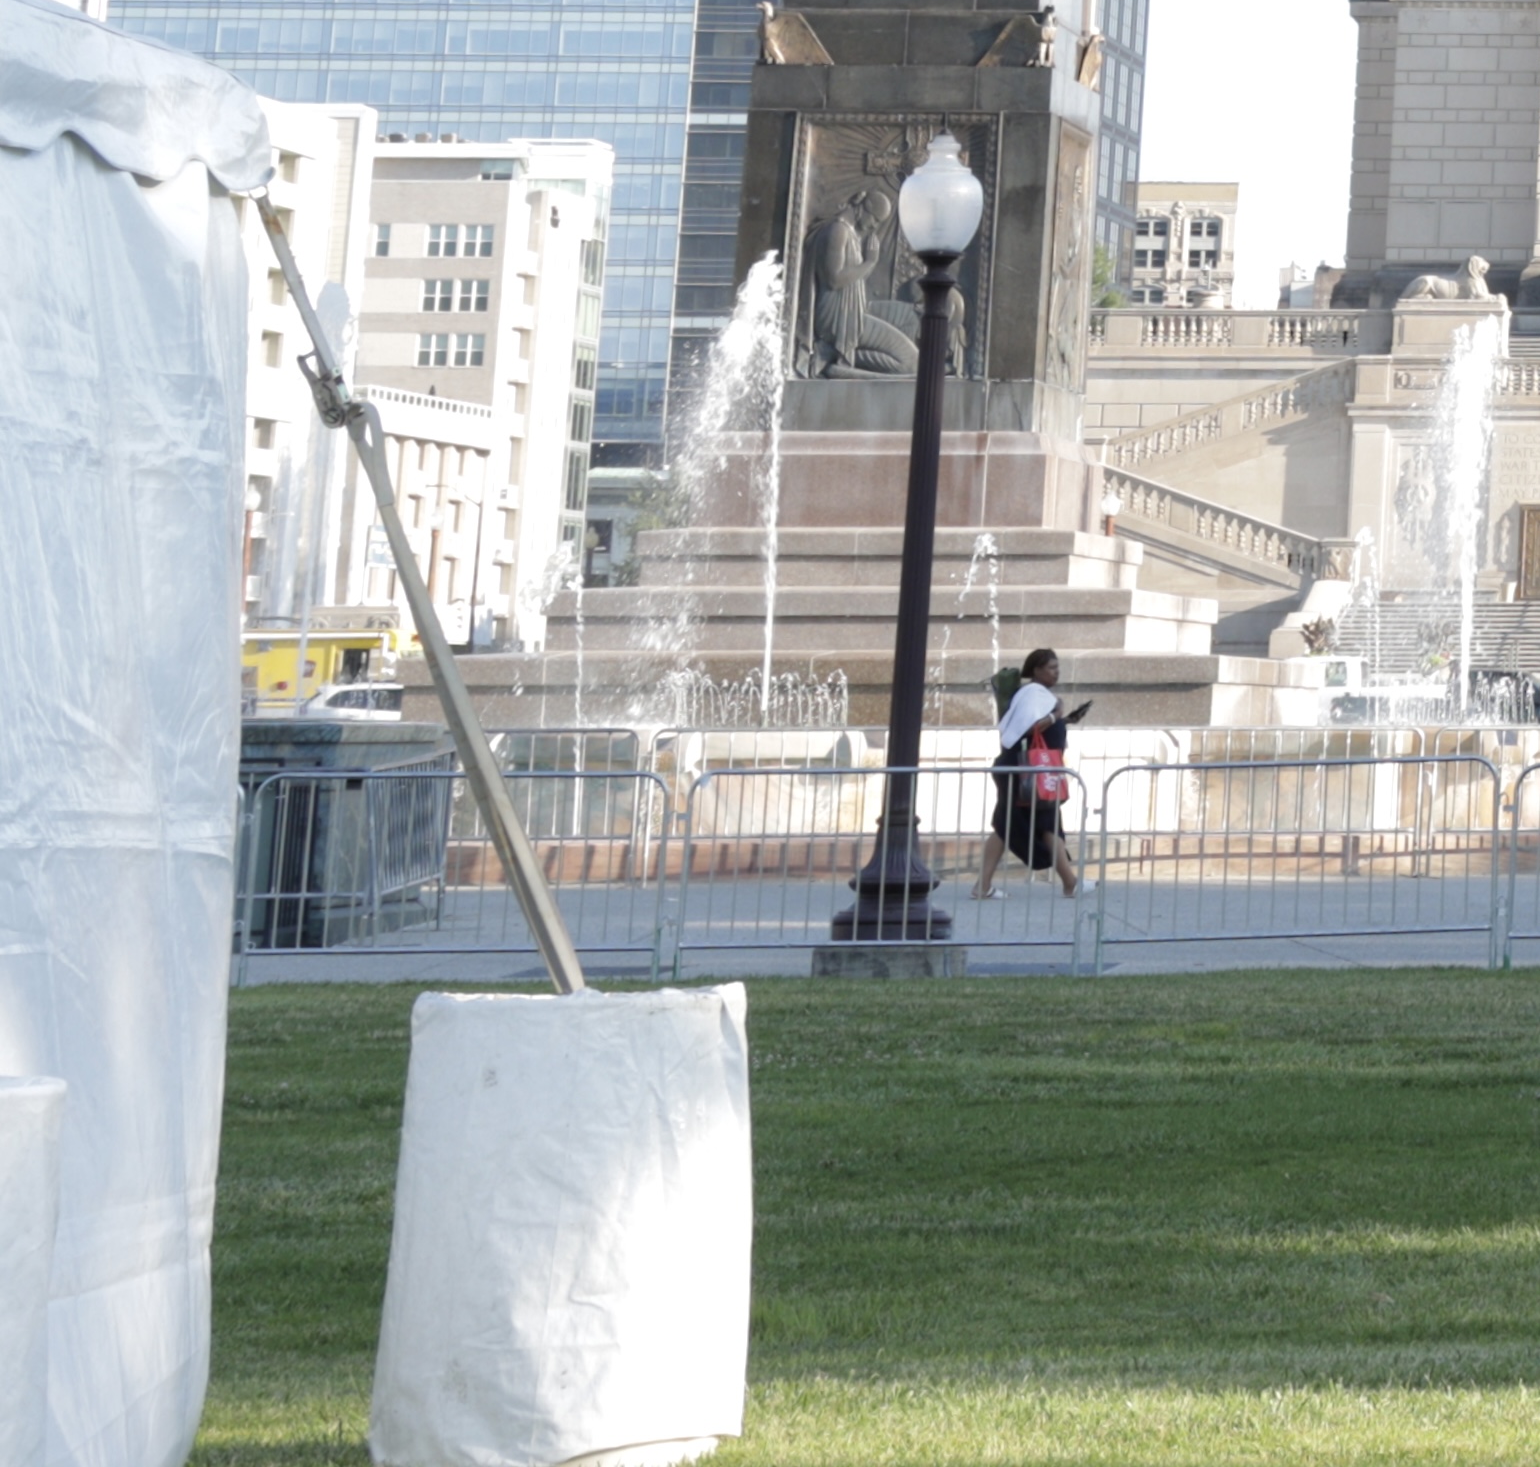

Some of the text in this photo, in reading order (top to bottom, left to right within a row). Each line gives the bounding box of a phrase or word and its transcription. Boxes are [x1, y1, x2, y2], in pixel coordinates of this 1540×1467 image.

[1503, 434, 1519, 445] TO
[1500, 461, 1528, 472] WAR
[1498, 488, 1527, 499] MAY
